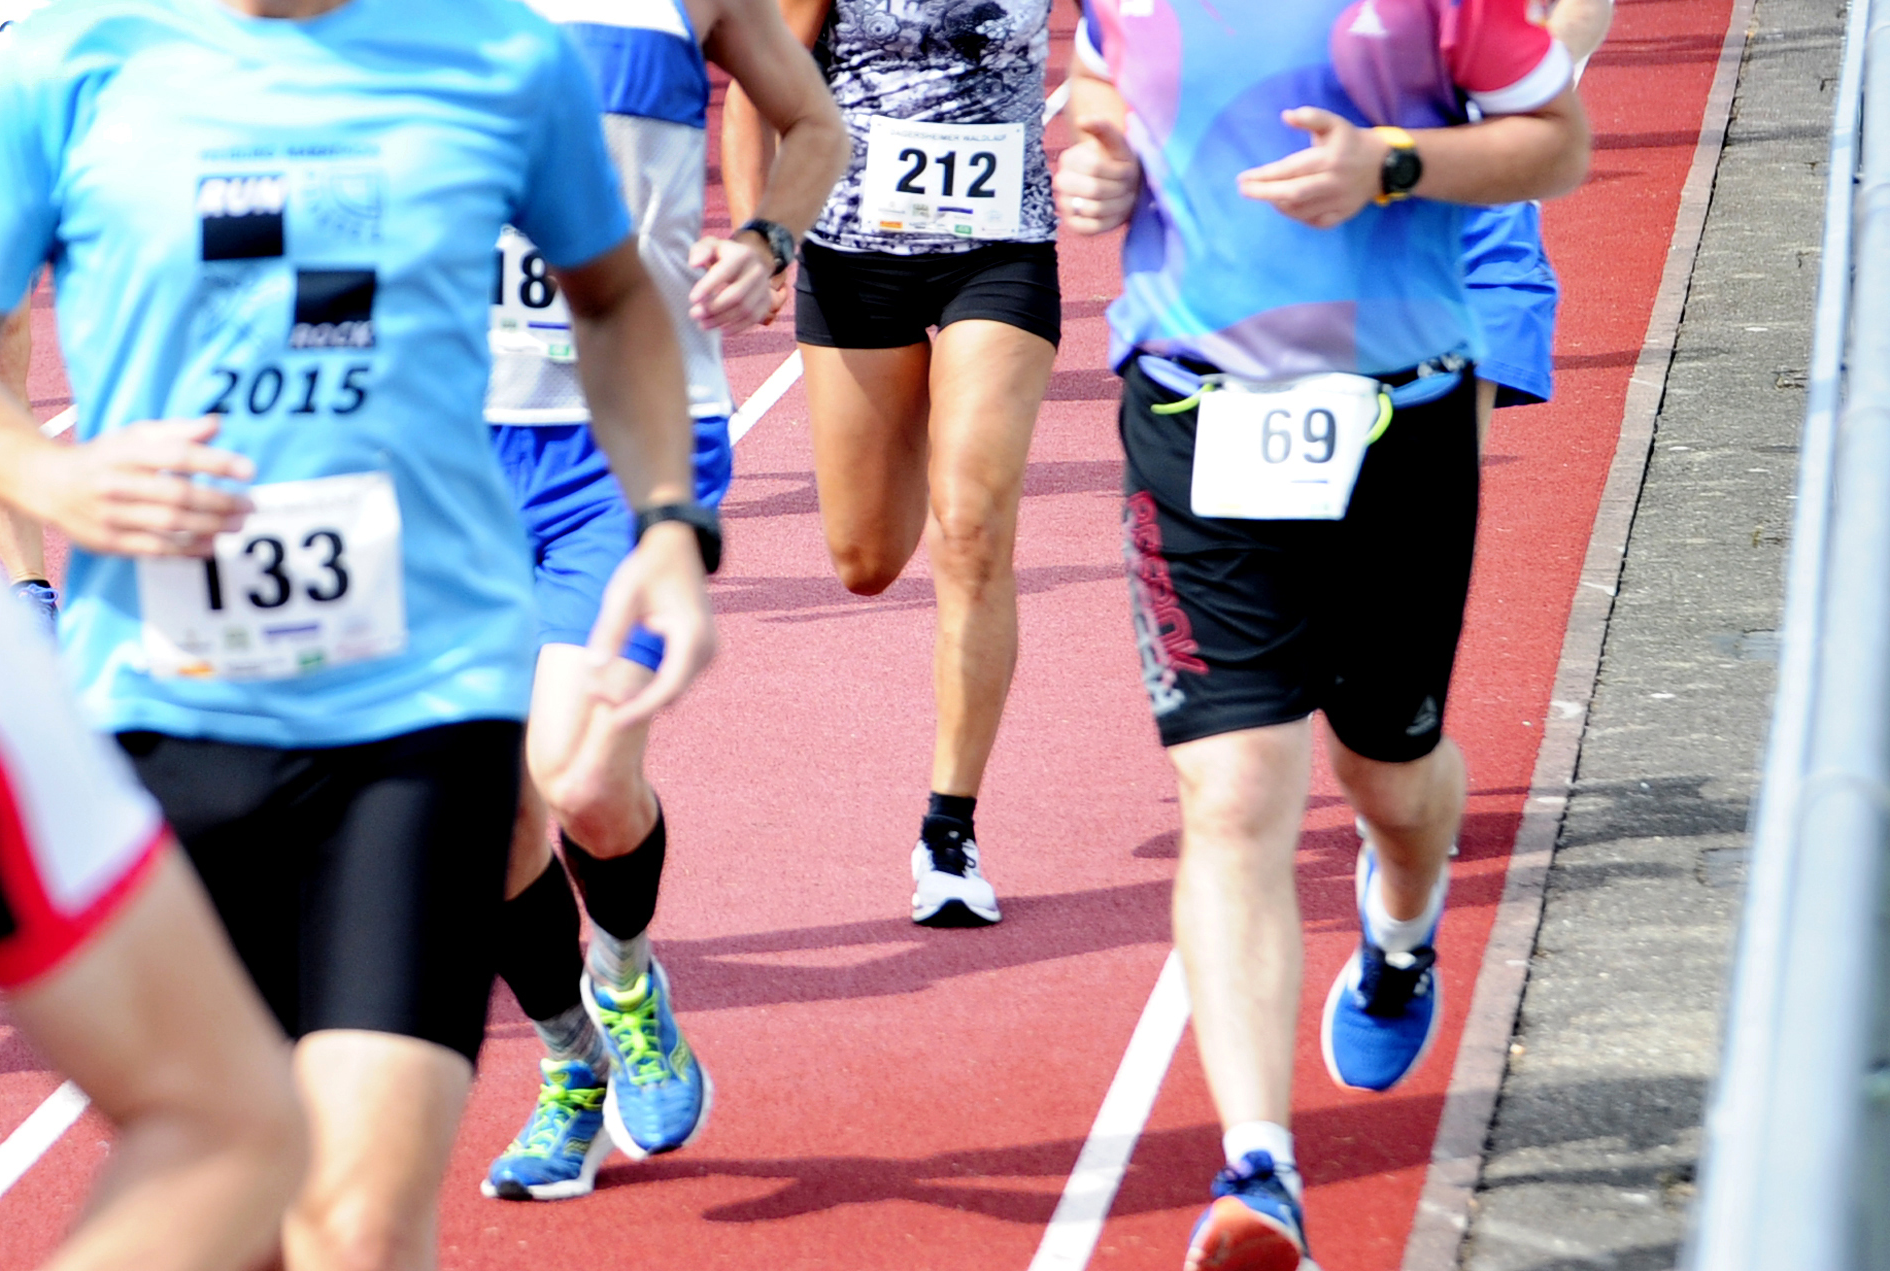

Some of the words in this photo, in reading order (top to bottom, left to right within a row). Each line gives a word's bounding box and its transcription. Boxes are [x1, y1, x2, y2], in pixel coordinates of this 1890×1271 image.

[197, 178, 287, 217] RUN
[895, 147, 997, 198] 212
[204, 366, 370, 414] 2015
[1260, 407, 1338, 465] 69
[205, 531, 349, 611] 133
